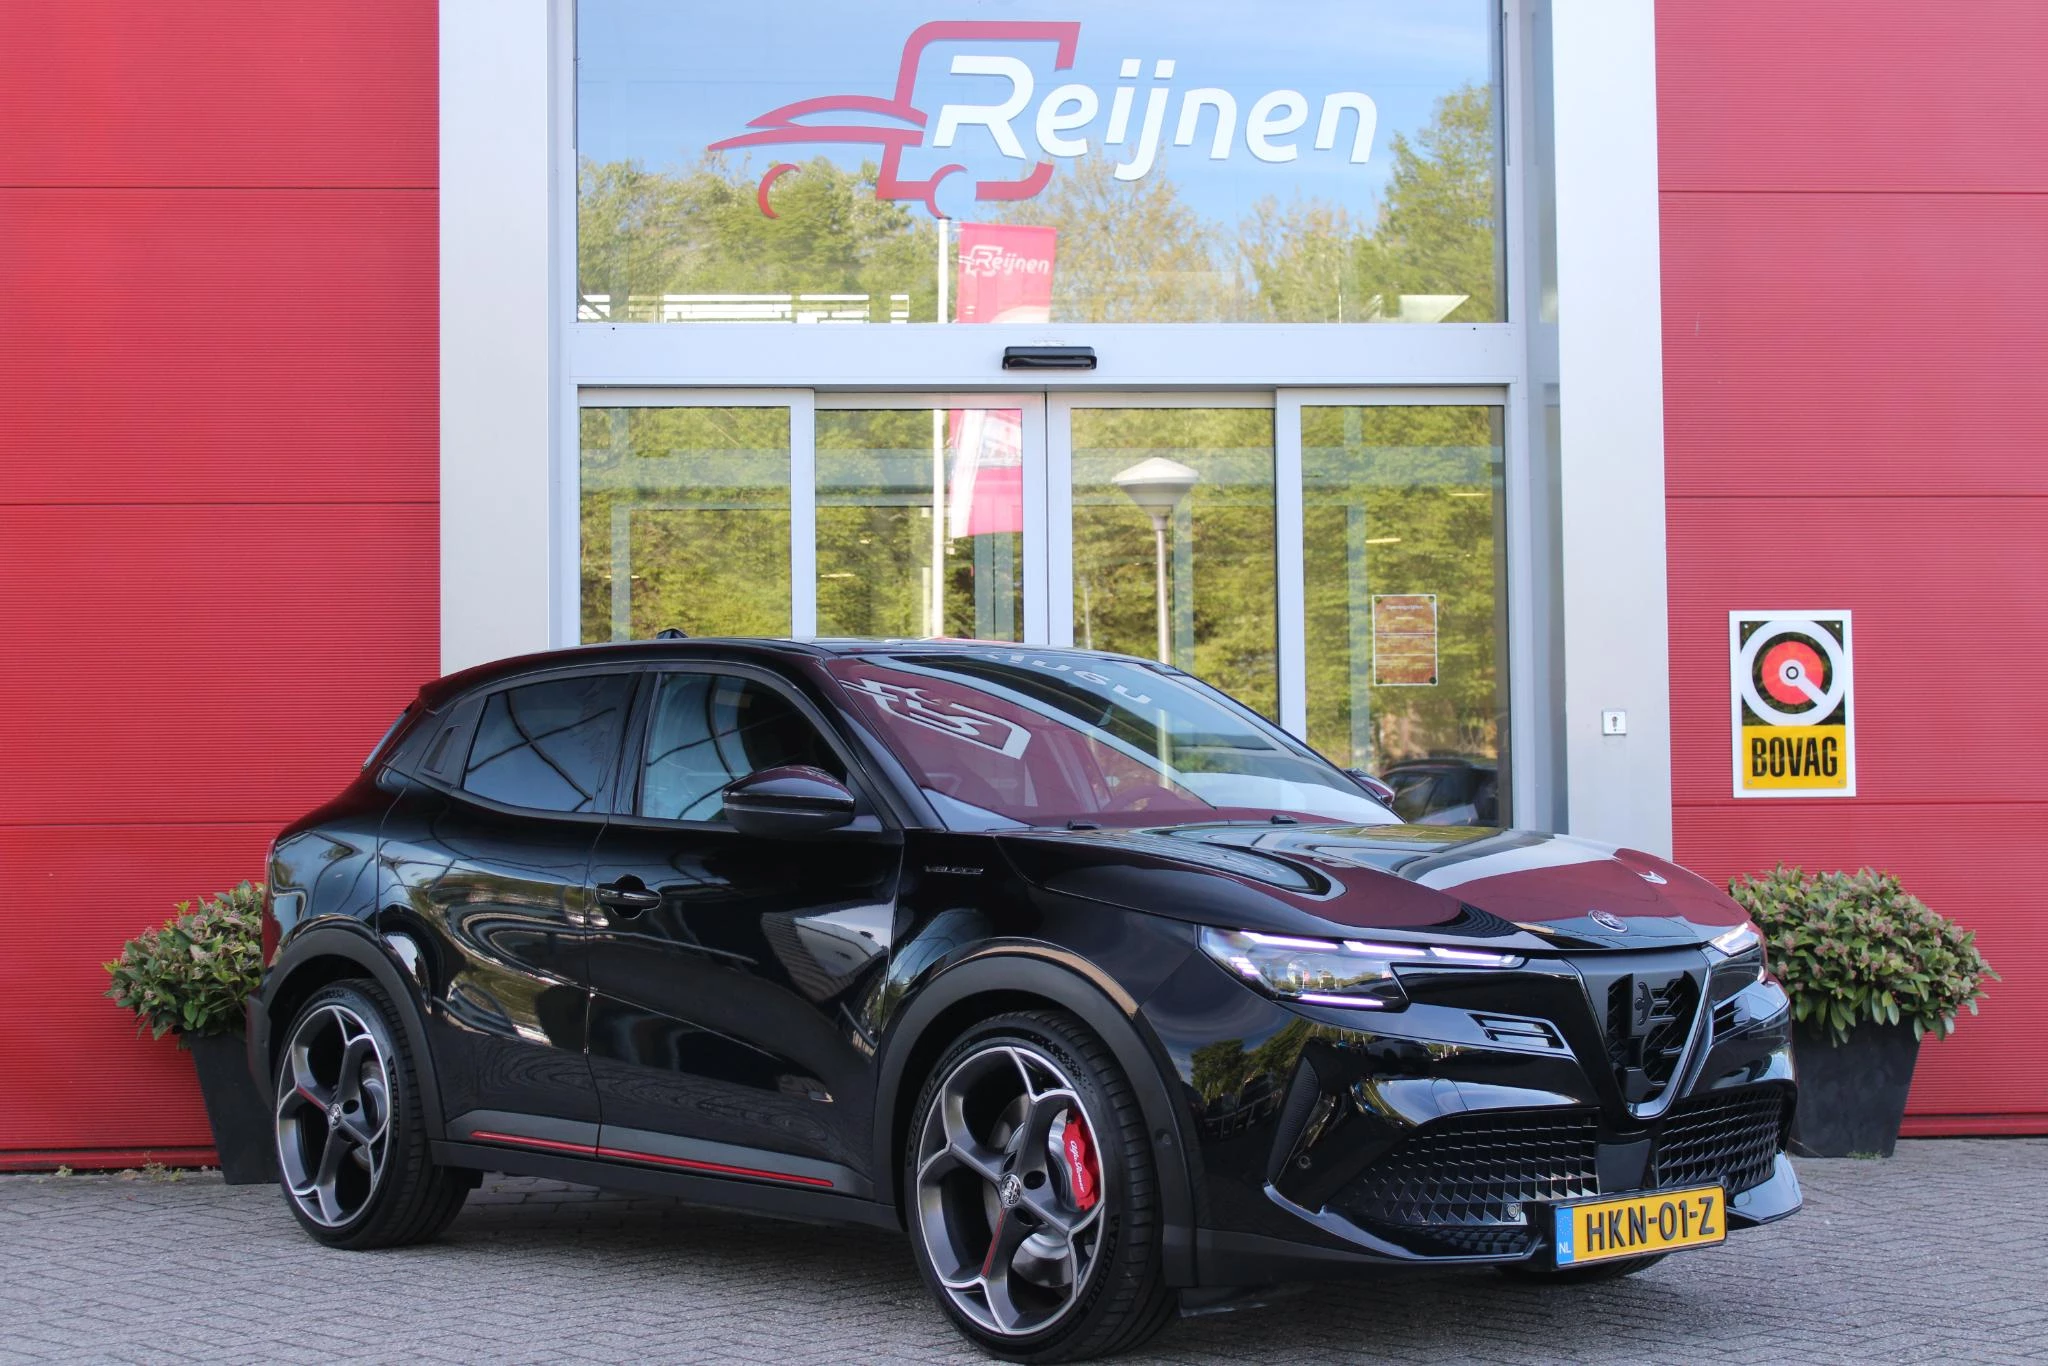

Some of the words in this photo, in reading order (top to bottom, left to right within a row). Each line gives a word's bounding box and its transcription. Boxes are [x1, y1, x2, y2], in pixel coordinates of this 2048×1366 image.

[933, 55, 1378, 181] Reijnen
[975, 251, 1050, 276] Reijnen
[1751, 736, 1838, 777] BOVAG
[1586, 1196, 1715, 1252] HKN-01-Z
[1558, 1241, 1572, 1255] NL
